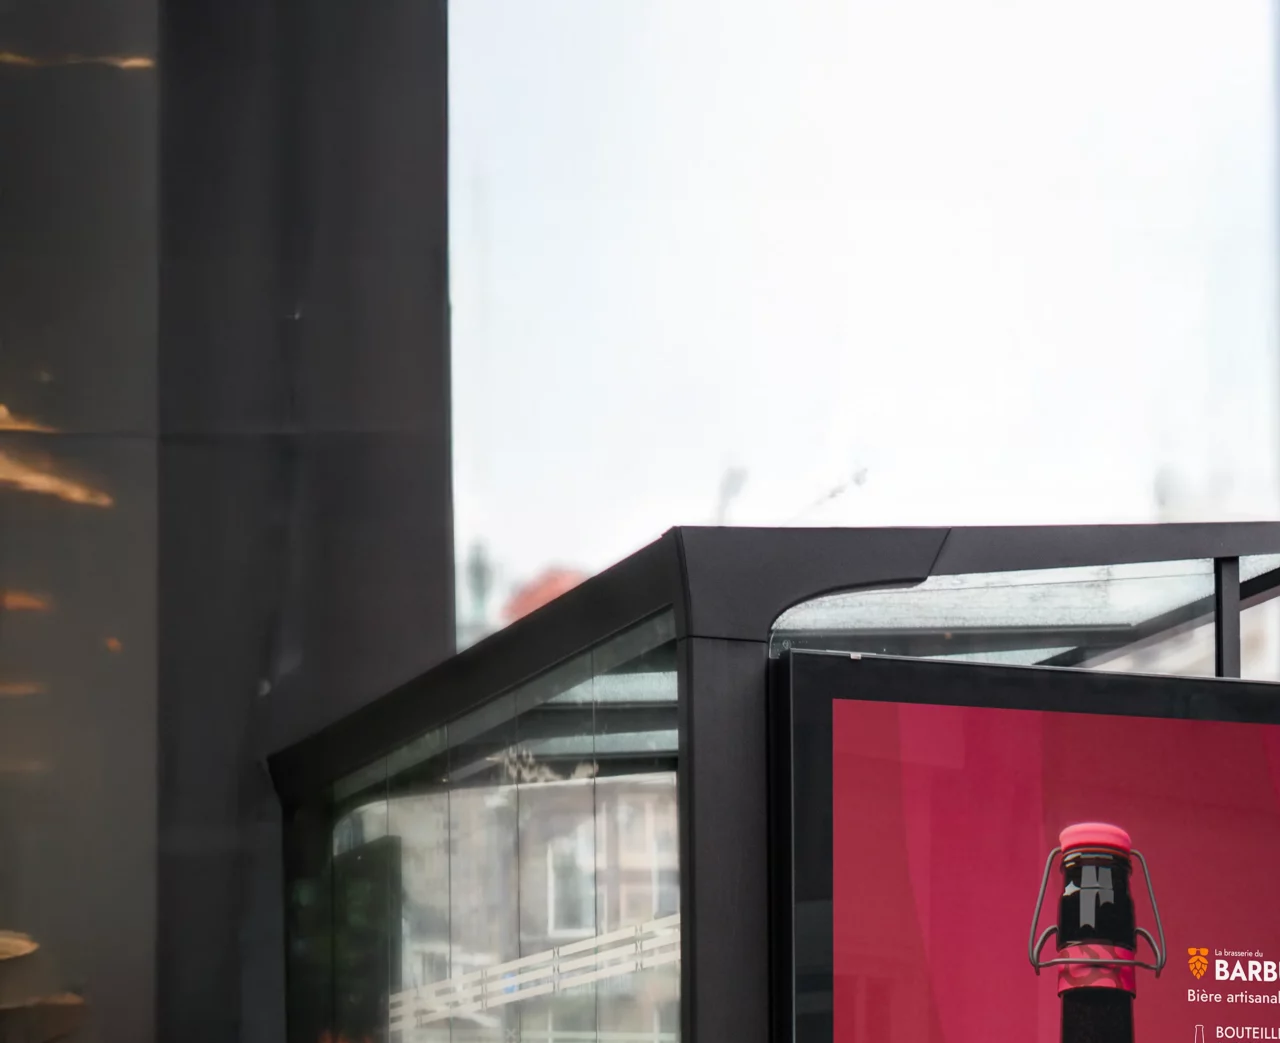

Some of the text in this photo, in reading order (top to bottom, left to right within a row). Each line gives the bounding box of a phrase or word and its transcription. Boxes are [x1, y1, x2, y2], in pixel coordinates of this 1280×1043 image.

[1223, 948, 1253, 957] brasserie
[1254, 950, 1264, 958] du
[1187, 989, 1222, 1003] Bière
